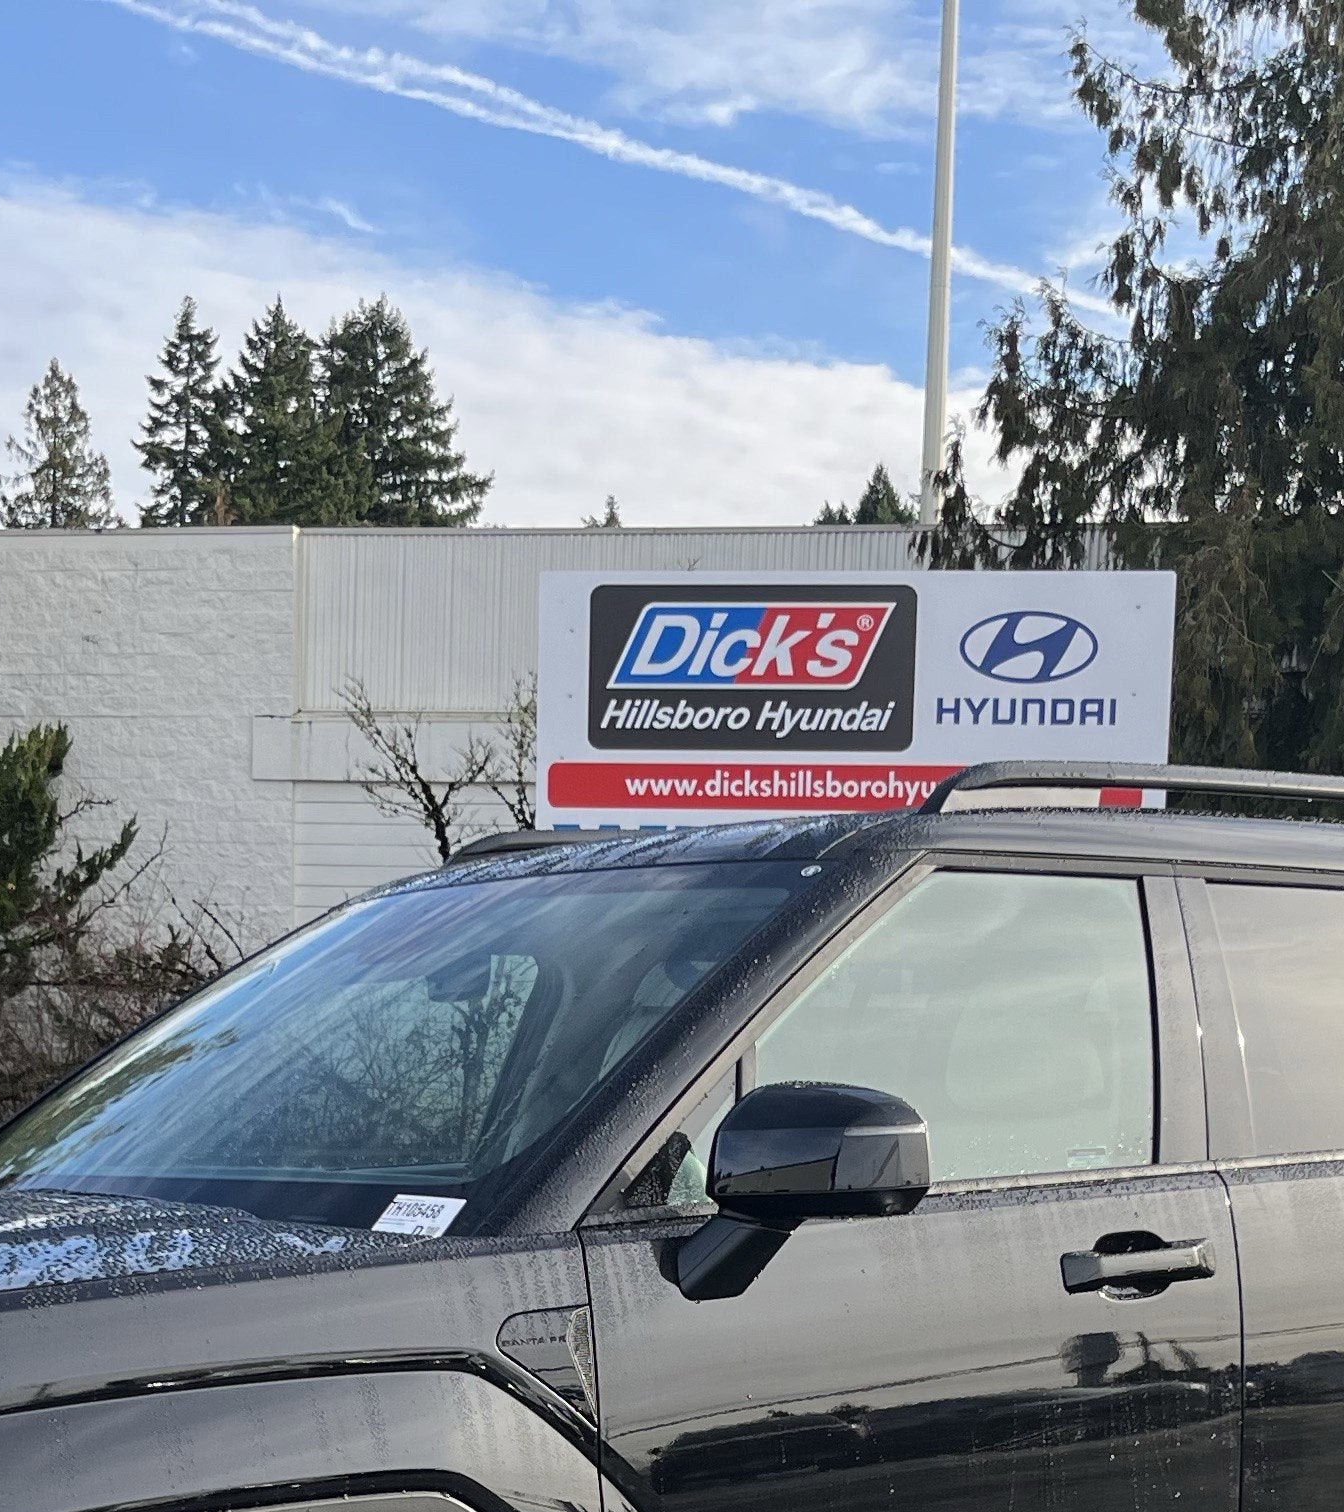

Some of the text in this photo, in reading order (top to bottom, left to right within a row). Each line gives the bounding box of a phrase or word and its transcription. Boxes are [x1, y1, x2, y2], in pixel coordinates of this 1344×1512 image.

[630, 612, 860, 678] Dick's
[600, 698, 896, 738] Hillsboro Hyundai
[935, 697, 1117, 726] HYUNDAI
